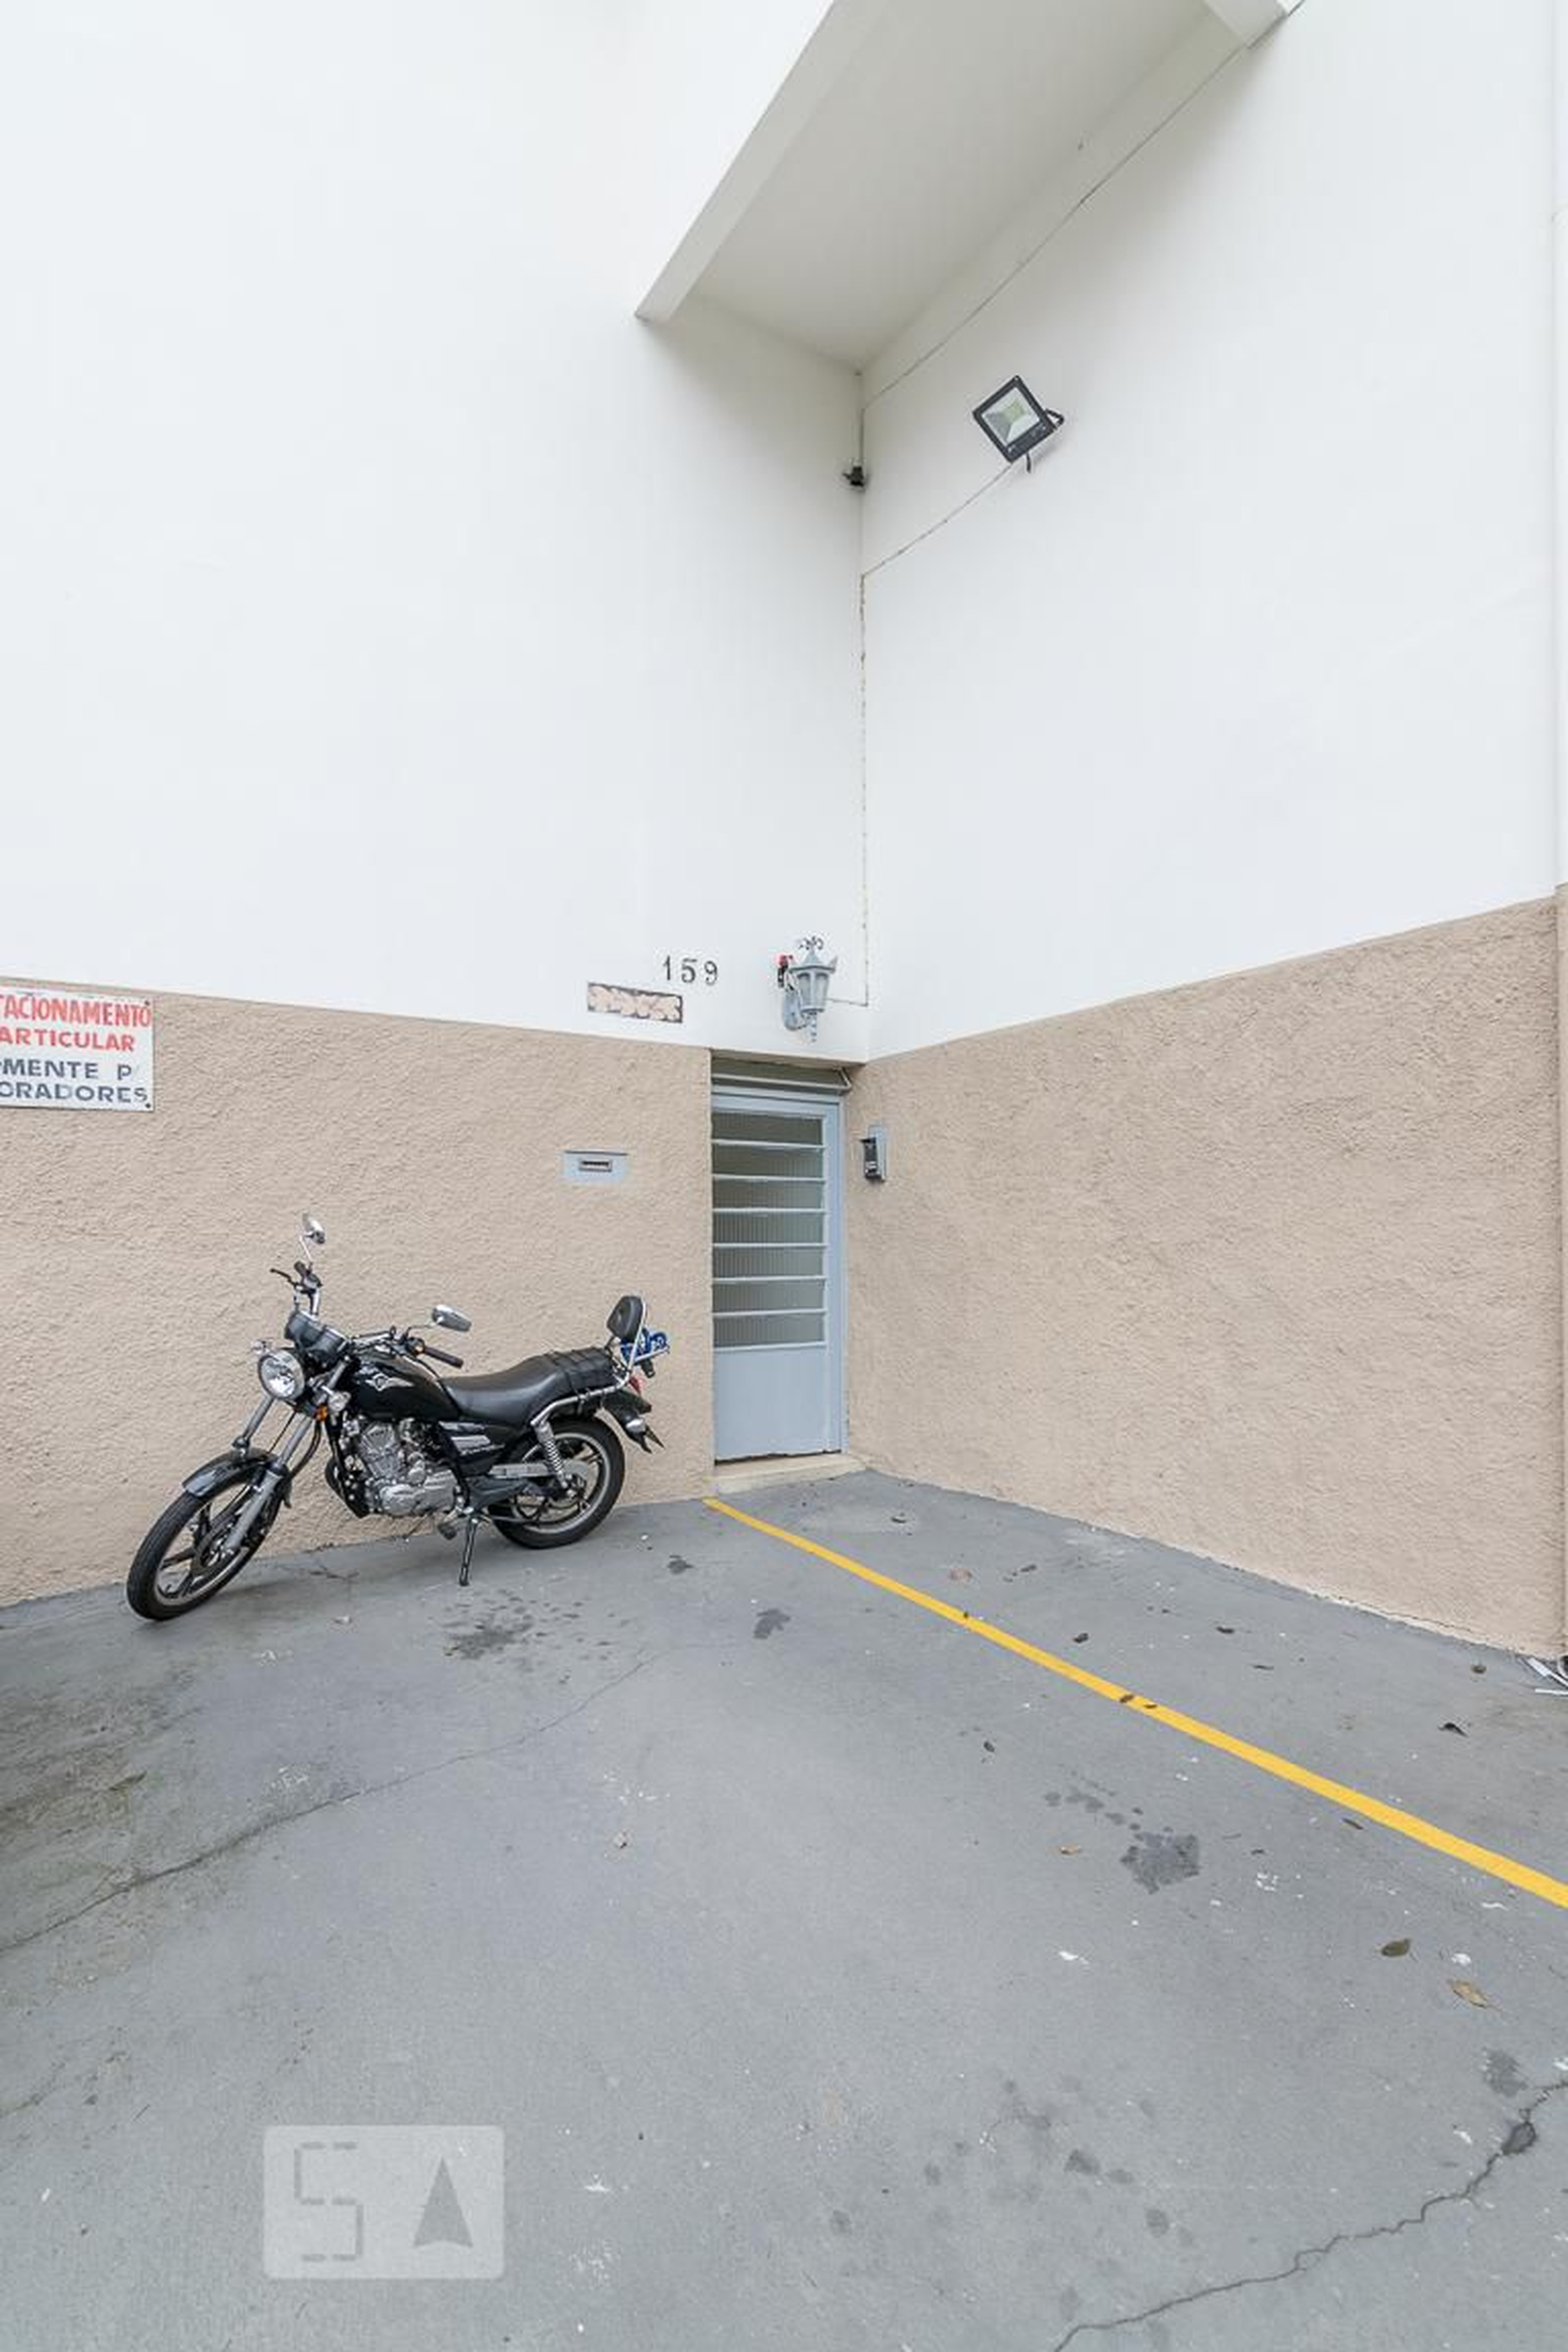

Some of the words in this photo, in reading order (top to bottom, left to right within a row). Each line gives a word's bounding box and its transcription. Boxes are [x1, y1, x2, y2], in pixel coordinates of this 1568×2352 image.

[662, 954, 717, 986] 159
[0, 993, 150, 1027] ACIONAMENTO
[0, 1058, 98, 1079] MENTE
[0, 1081, 147, 1103] ORADORES
